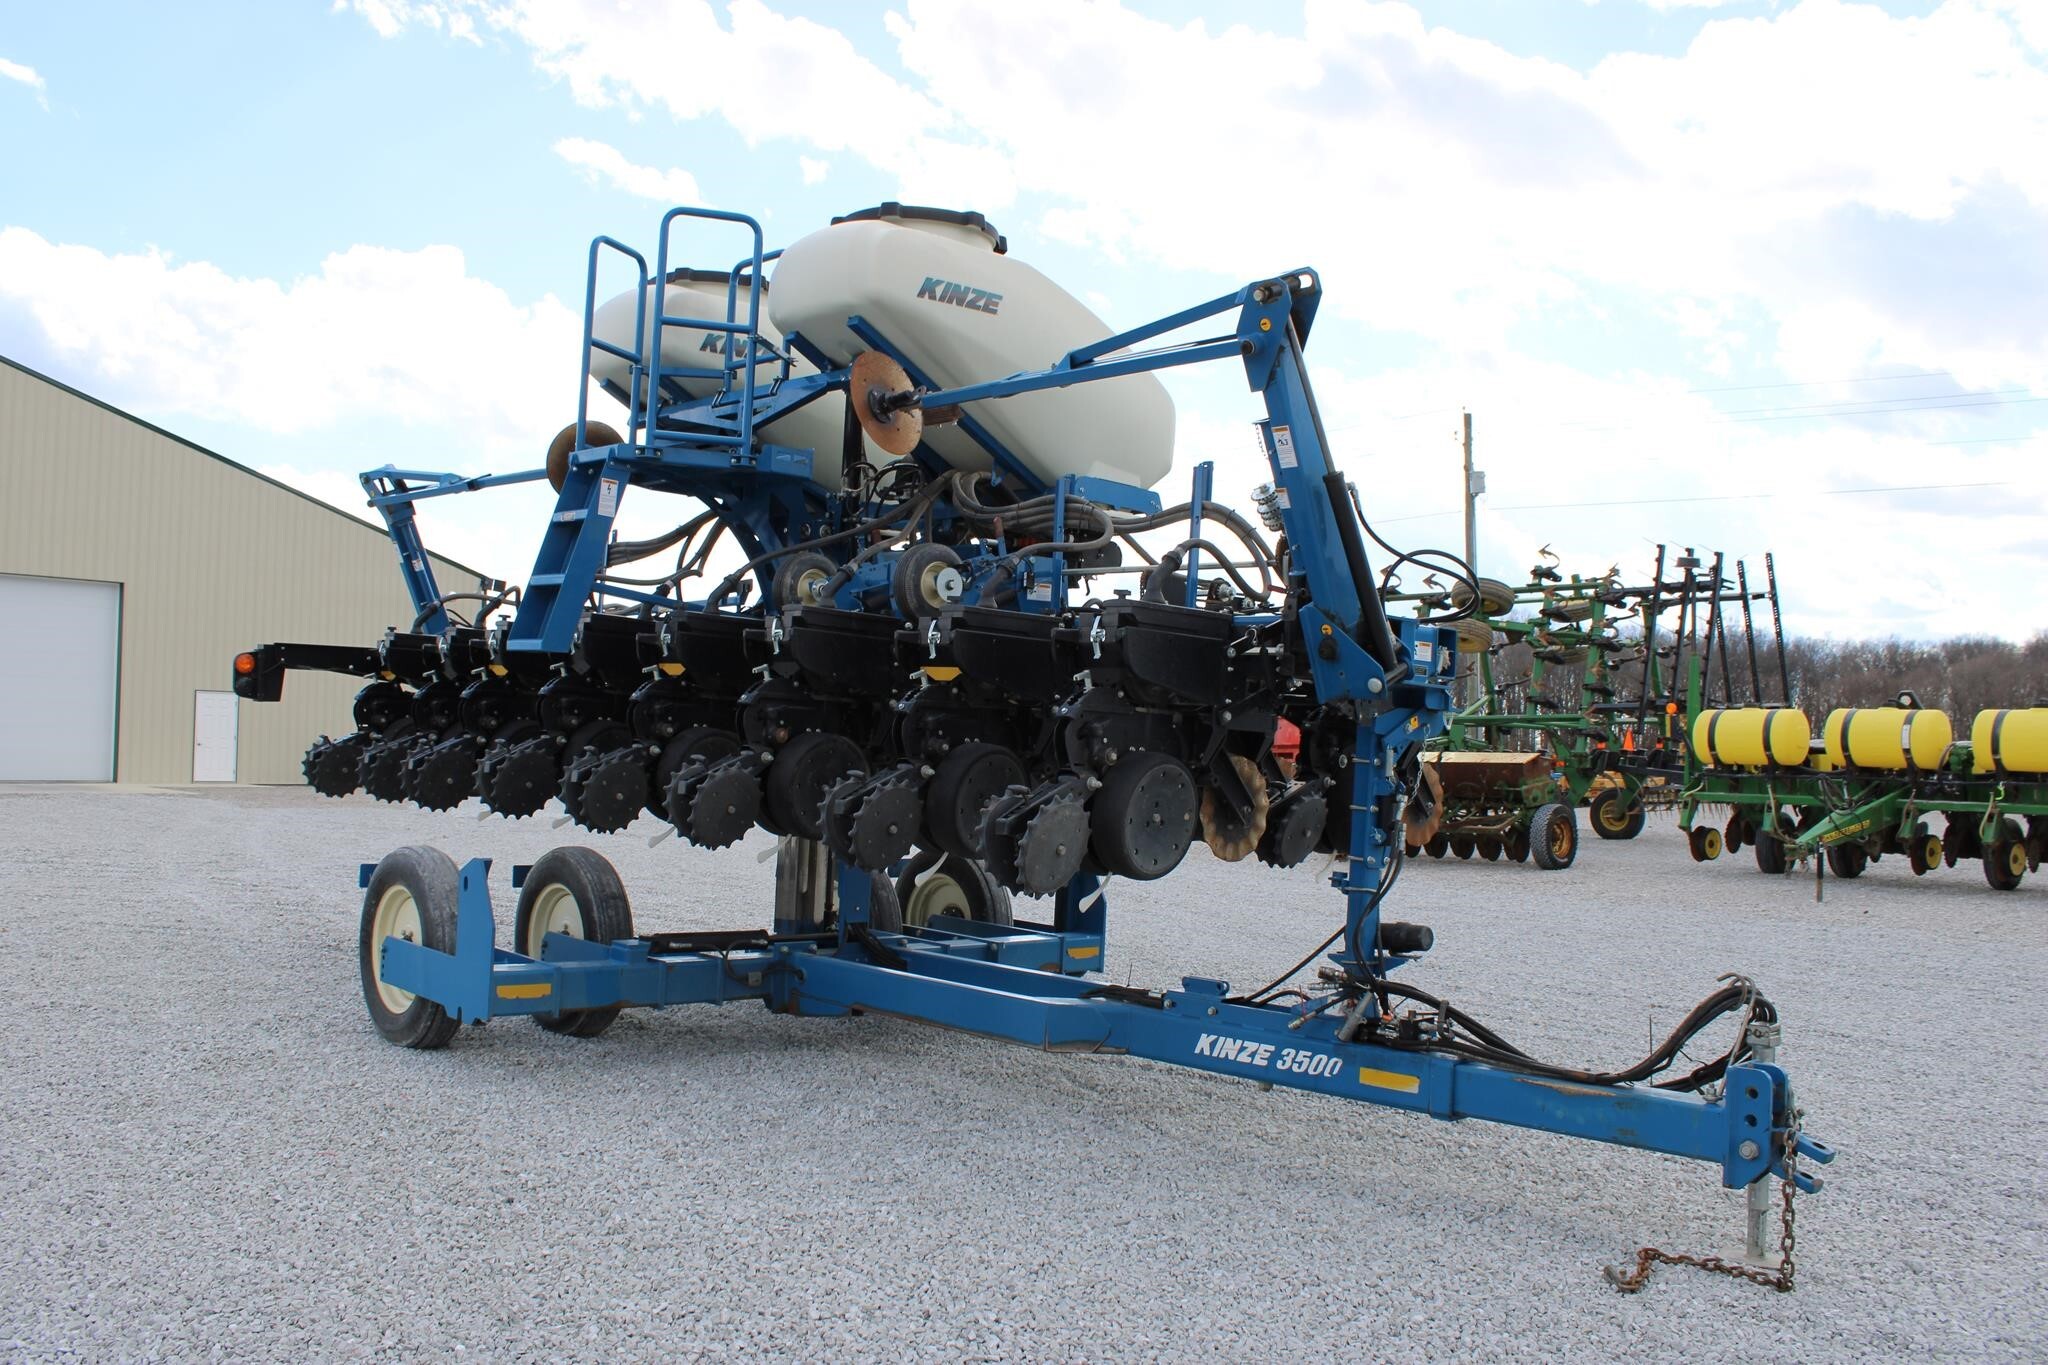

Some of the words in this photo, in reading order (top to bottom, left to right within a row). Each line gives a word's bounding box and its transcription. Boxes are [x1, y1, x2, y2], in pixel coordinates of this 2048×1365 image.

[916, 276, 1003, 315] KINZE
[1194, 1033, 1275, 1067] KINZE
[1276, 1047, 1343, 1077] 3500
